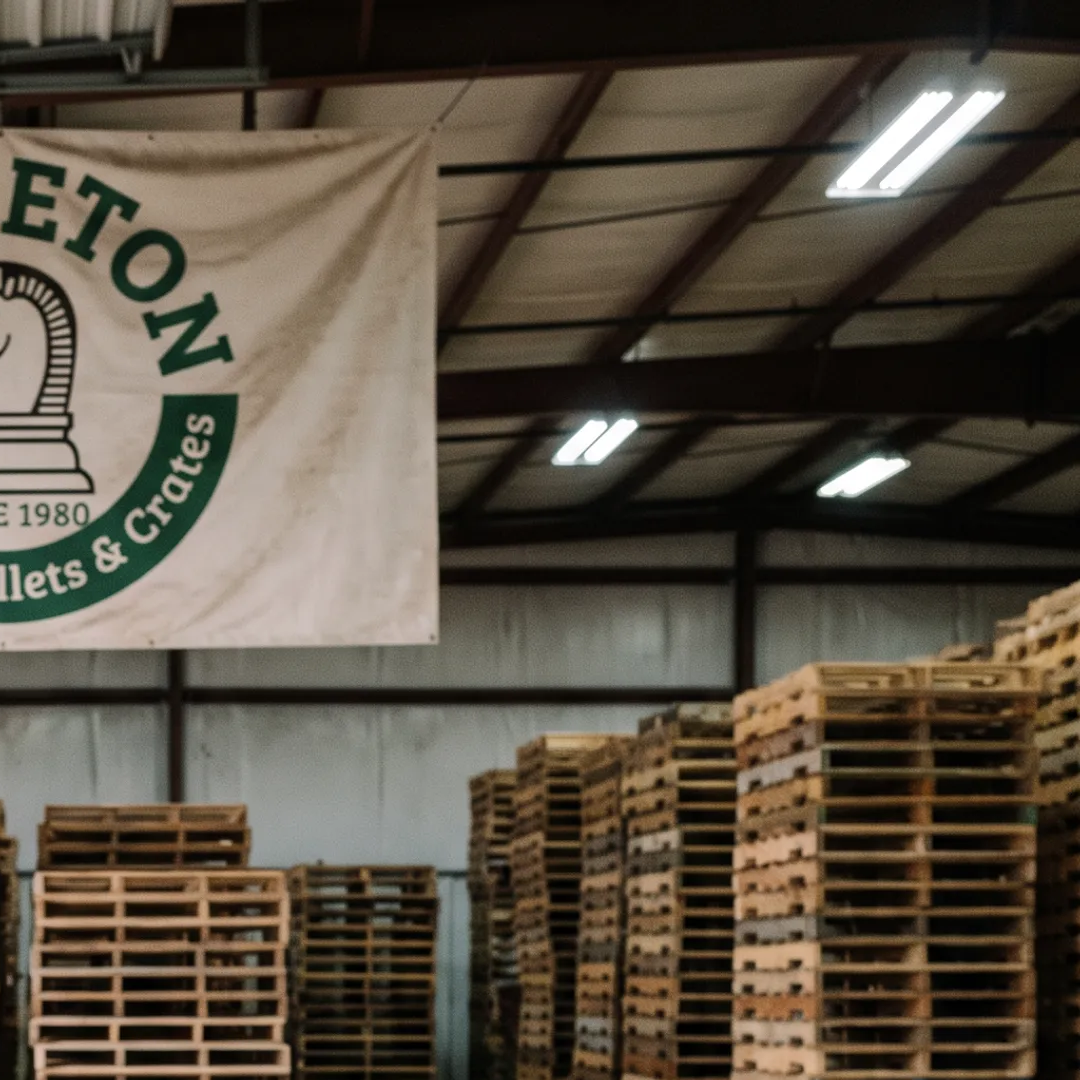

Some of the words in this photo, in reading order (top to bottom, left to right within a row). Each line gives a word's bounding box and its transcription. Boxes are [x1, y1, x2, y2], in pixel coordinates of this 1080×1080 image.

[19, 502, 90, 527] 1980
[92, 535, 129, 574] &
[124, 413, 216, 544] Crates
